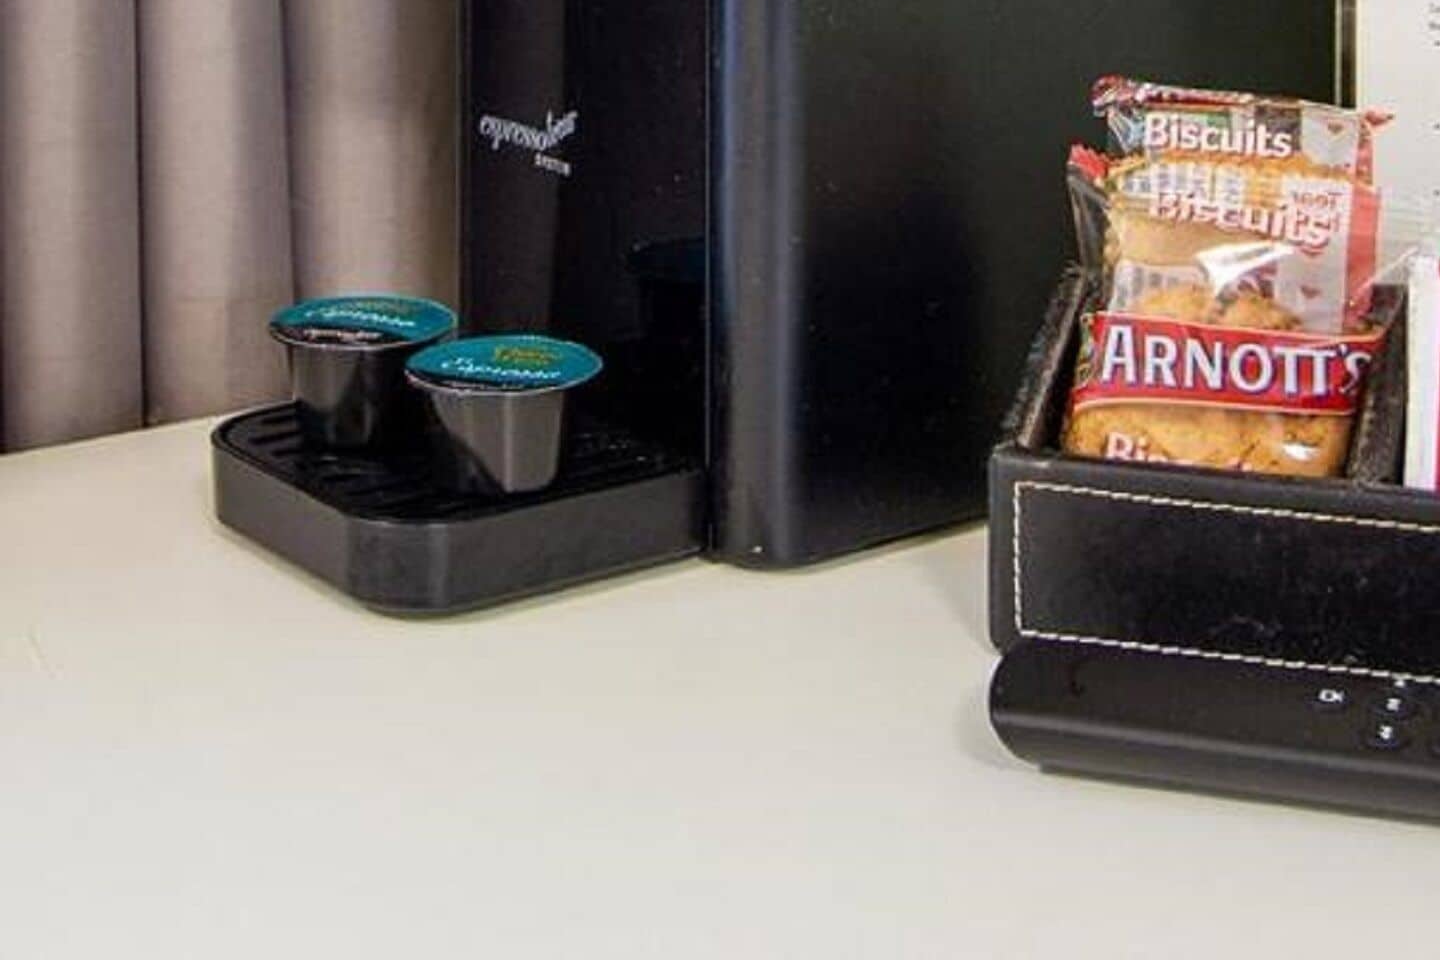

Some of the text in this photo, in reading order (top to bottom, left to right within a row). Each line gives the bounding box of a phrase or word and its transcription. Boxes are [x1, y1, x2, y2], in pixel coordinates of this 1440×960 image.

[1144, 114, 1292, 156] Biscuits
[1150, 190, 1332, 252] Biscuits
[1102, 324, 1372, 396] ARNOTT'S
